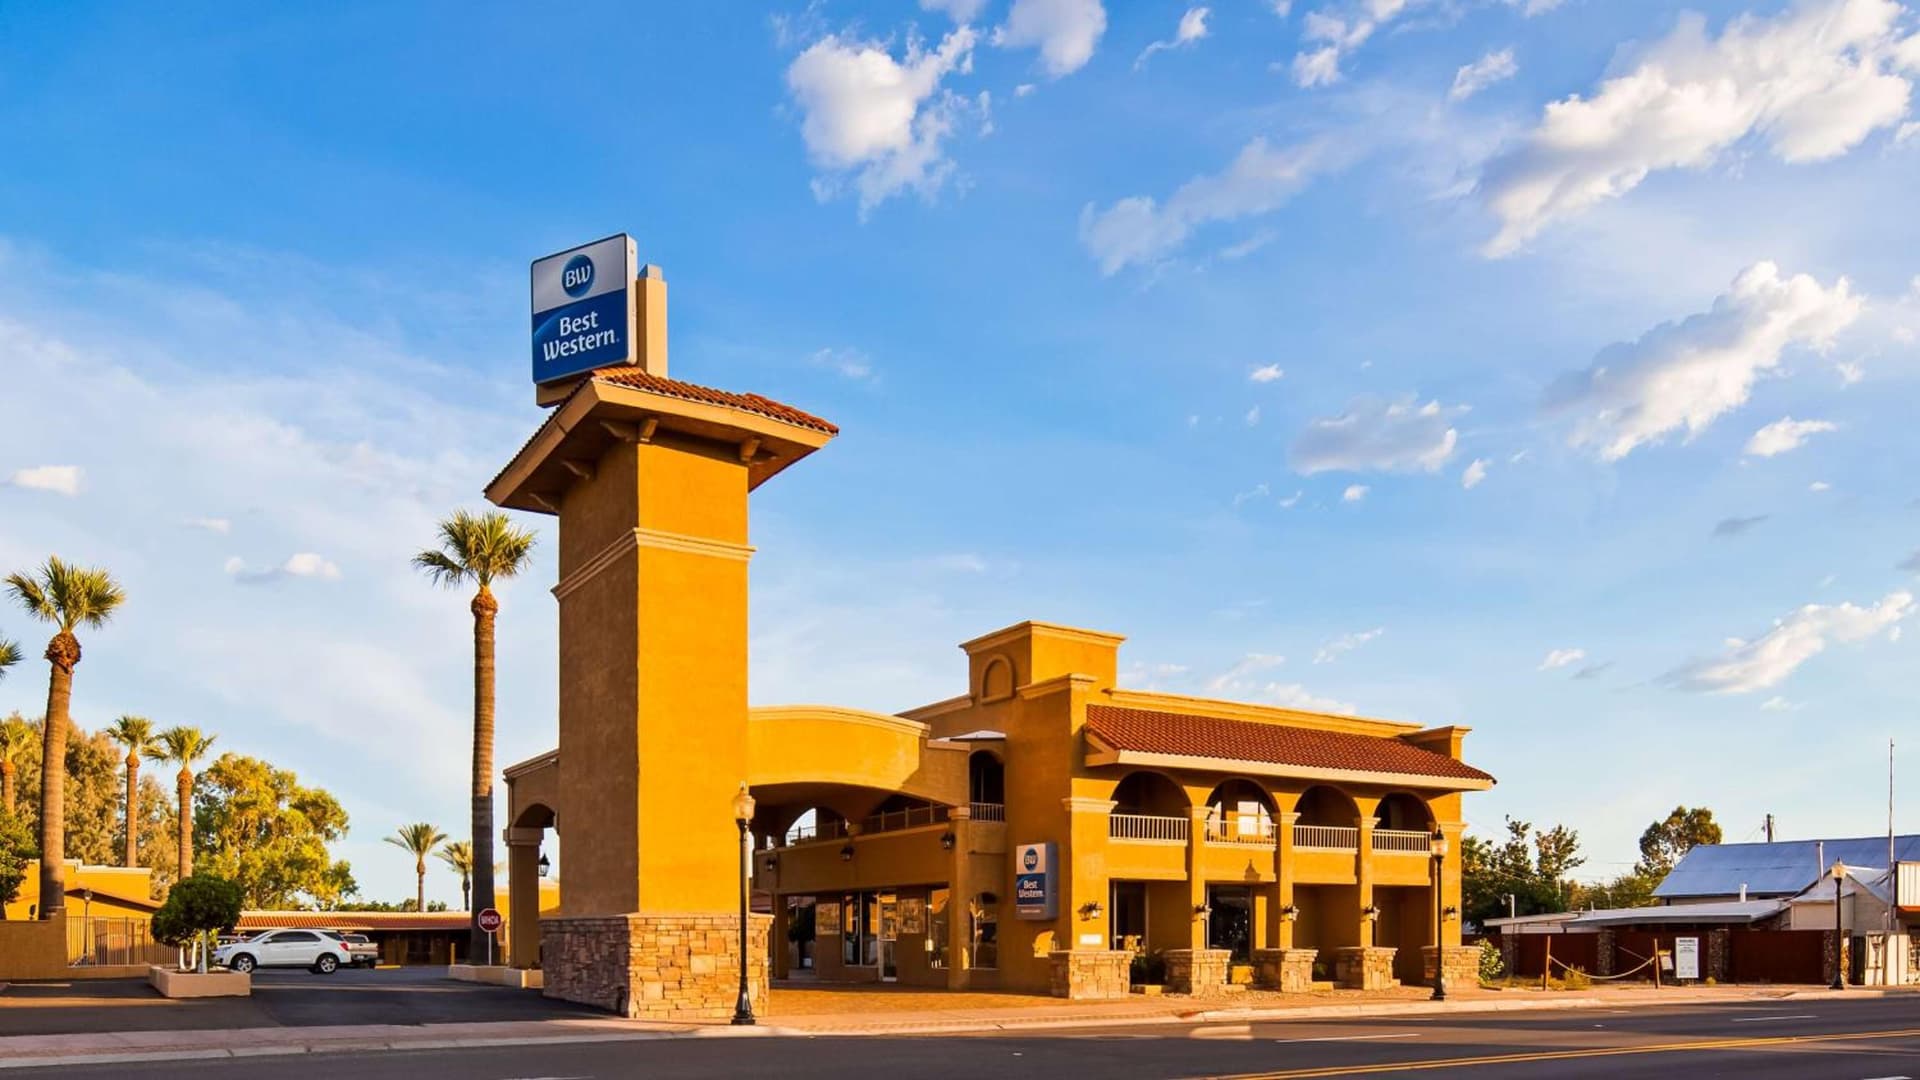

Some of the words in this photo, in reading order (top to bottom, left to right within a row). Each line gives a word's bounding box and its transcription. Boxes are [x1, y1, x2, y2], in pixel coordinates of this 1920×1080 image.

[565, 264, 591, 288] BW
[559, 310, 599, 337] Best
[542, 328, 616, 361] Western
[1023, 880, 1038, 889] Best
